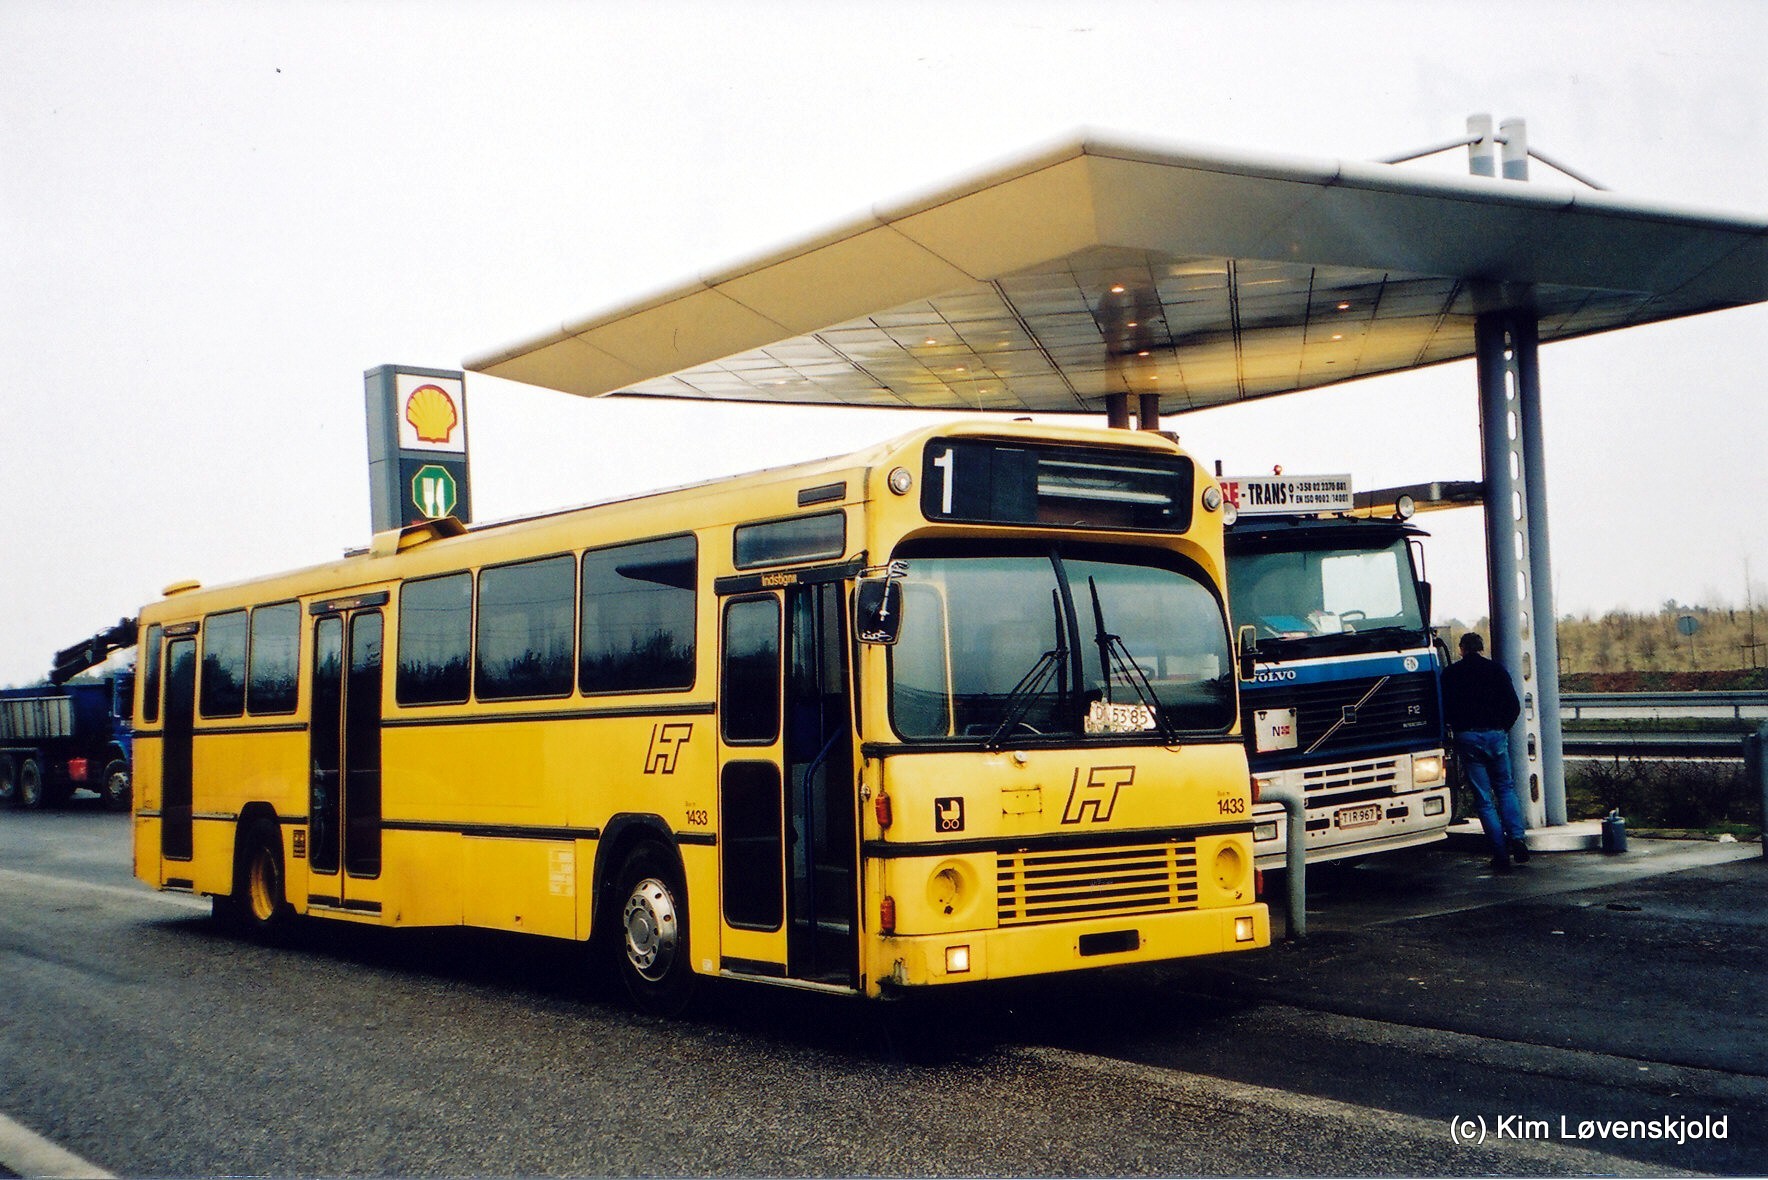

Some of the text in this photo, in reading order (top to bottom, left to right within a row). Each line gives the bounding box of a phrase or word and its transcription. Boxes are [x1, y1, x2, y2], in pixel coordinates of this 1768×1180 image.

[933, 448, 953, 514] 1
[1248, 482, 1286, 505] TRANS
[1217, 797, 1245, 815] 1433
[685, 809, 708, 826] 1433
